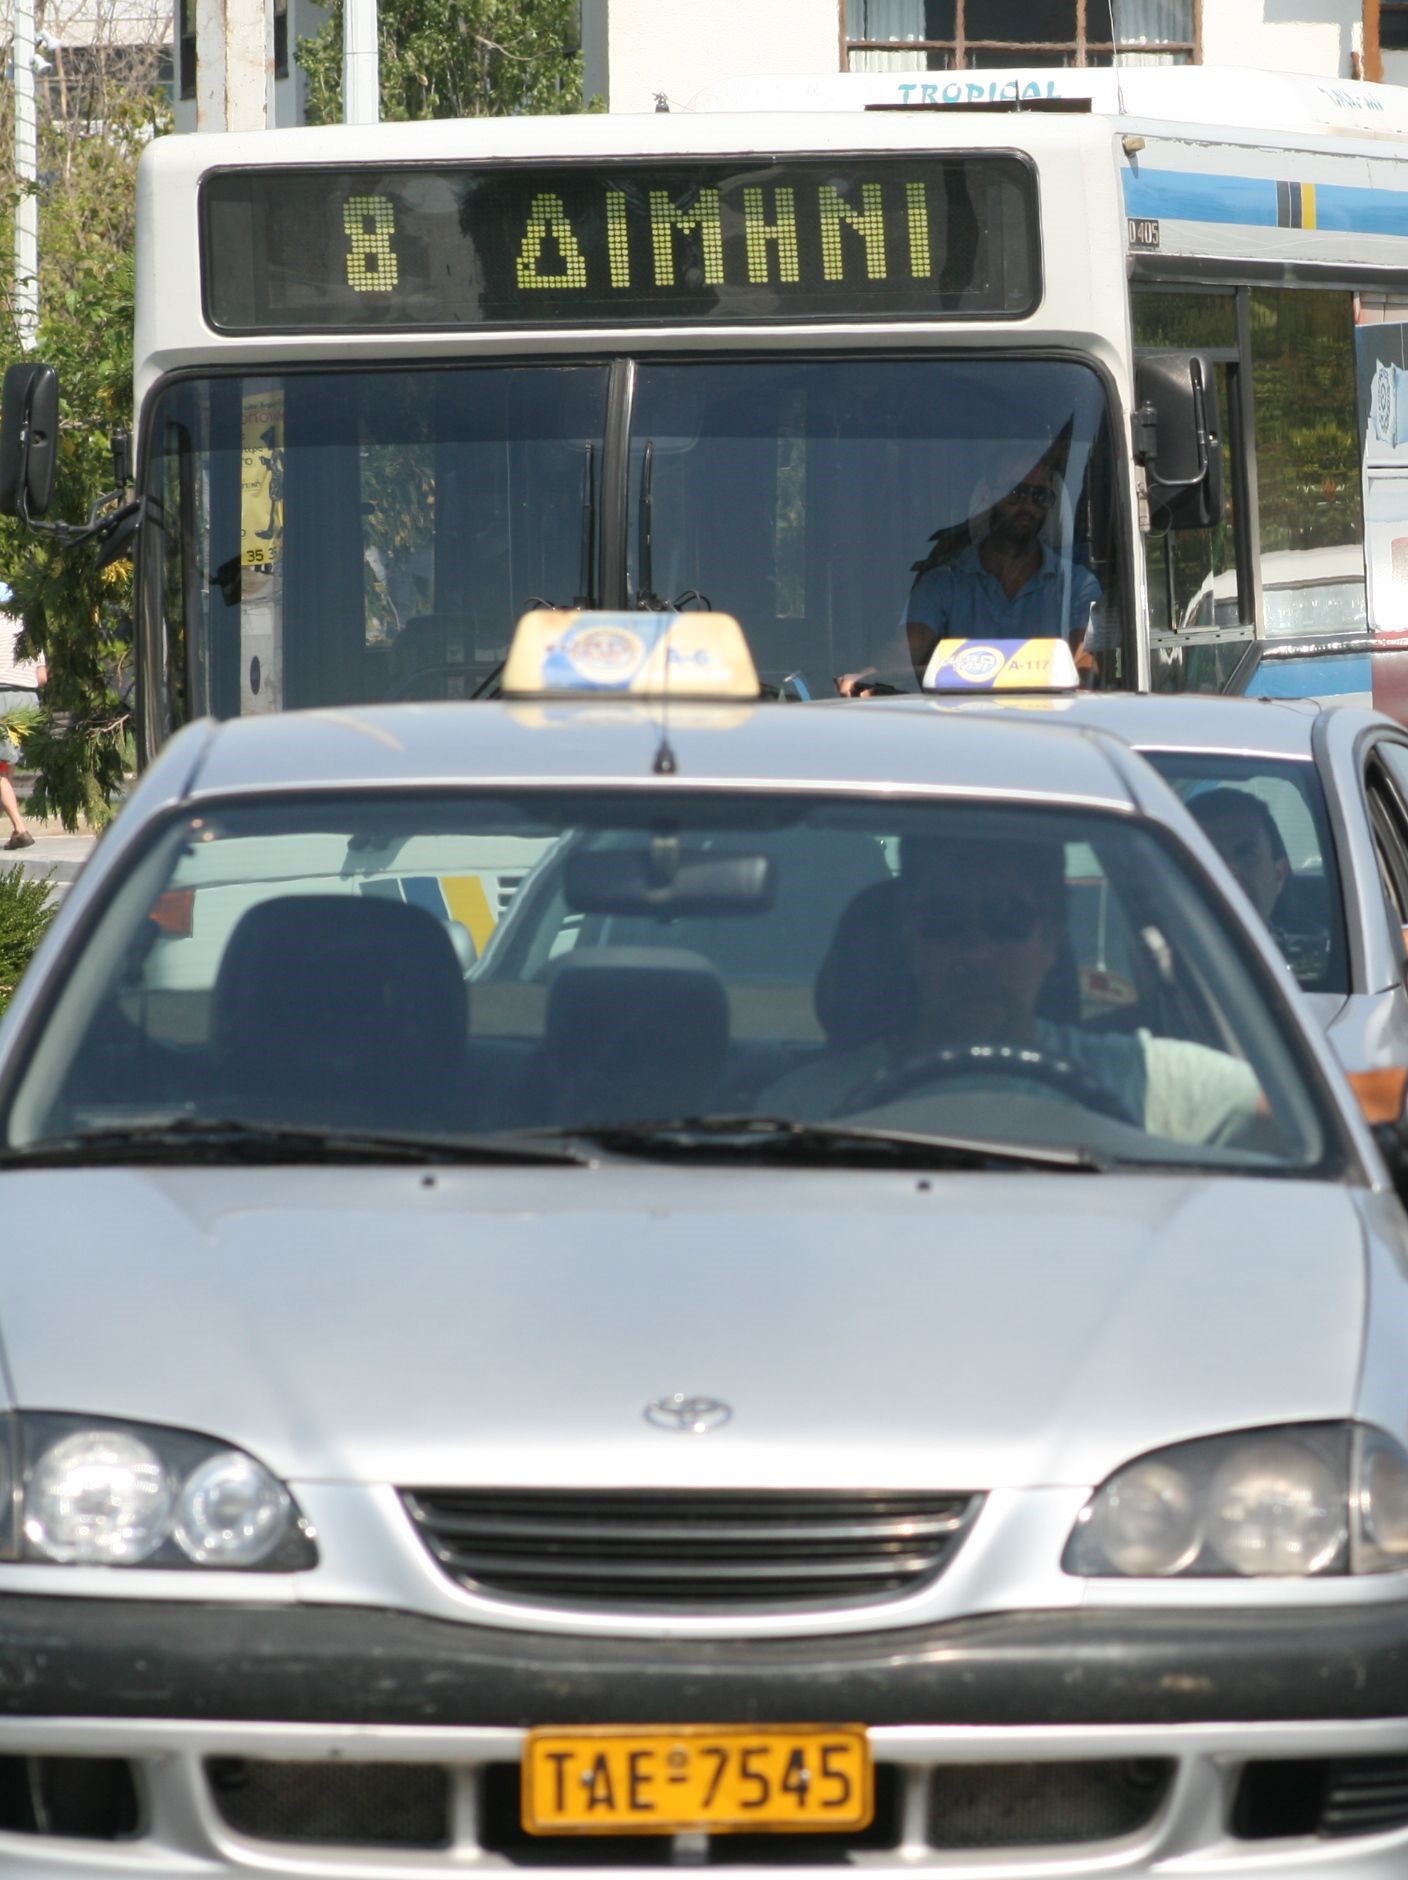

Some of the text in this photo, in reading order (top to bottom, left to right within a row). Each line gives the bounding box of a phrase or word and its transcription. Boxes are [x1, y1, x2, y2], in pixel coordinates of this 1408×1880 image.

[897, 81, 1062, 104] TROPICAL
[343, 182, 931, 292] 8 ΔΙΜΗΝΙ
